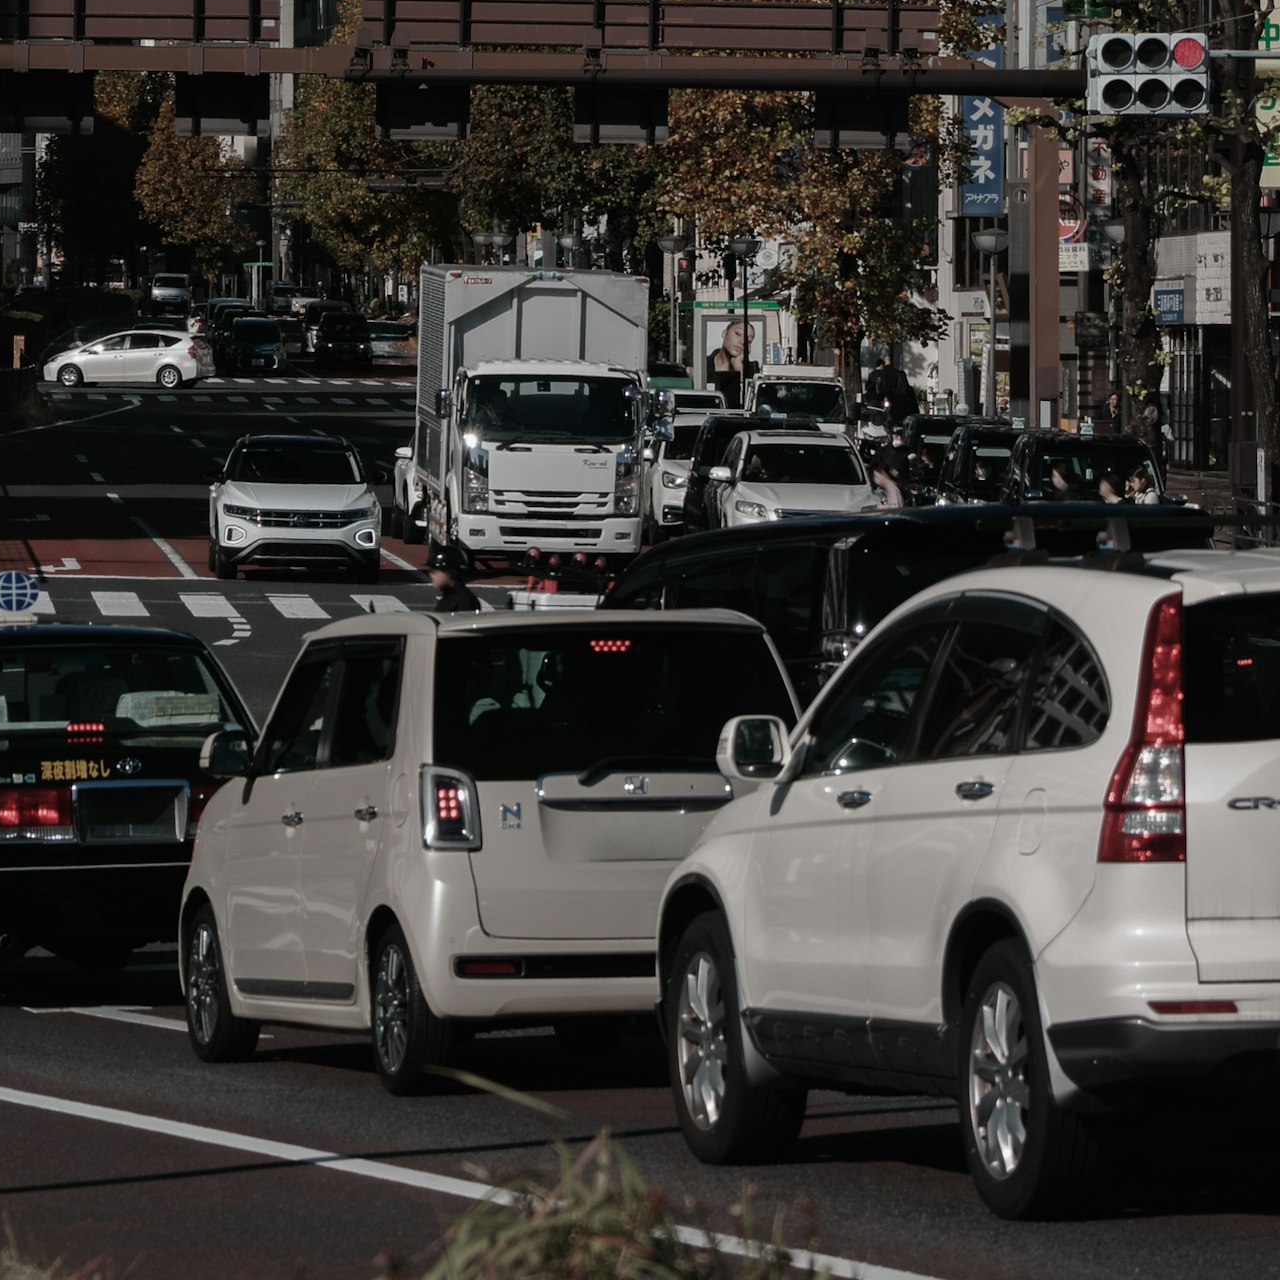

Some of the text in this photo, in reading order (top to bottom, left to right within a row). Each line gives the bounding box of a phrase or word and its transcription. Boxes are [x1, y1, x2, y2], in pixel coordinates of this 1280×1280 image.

[1092, 142, 1107, 205] 不動産
[965, 194, 999, 204] アサクラ
[40, 760, 110, 781] 深夜割増なし
[500, 802, 521, 821] N
